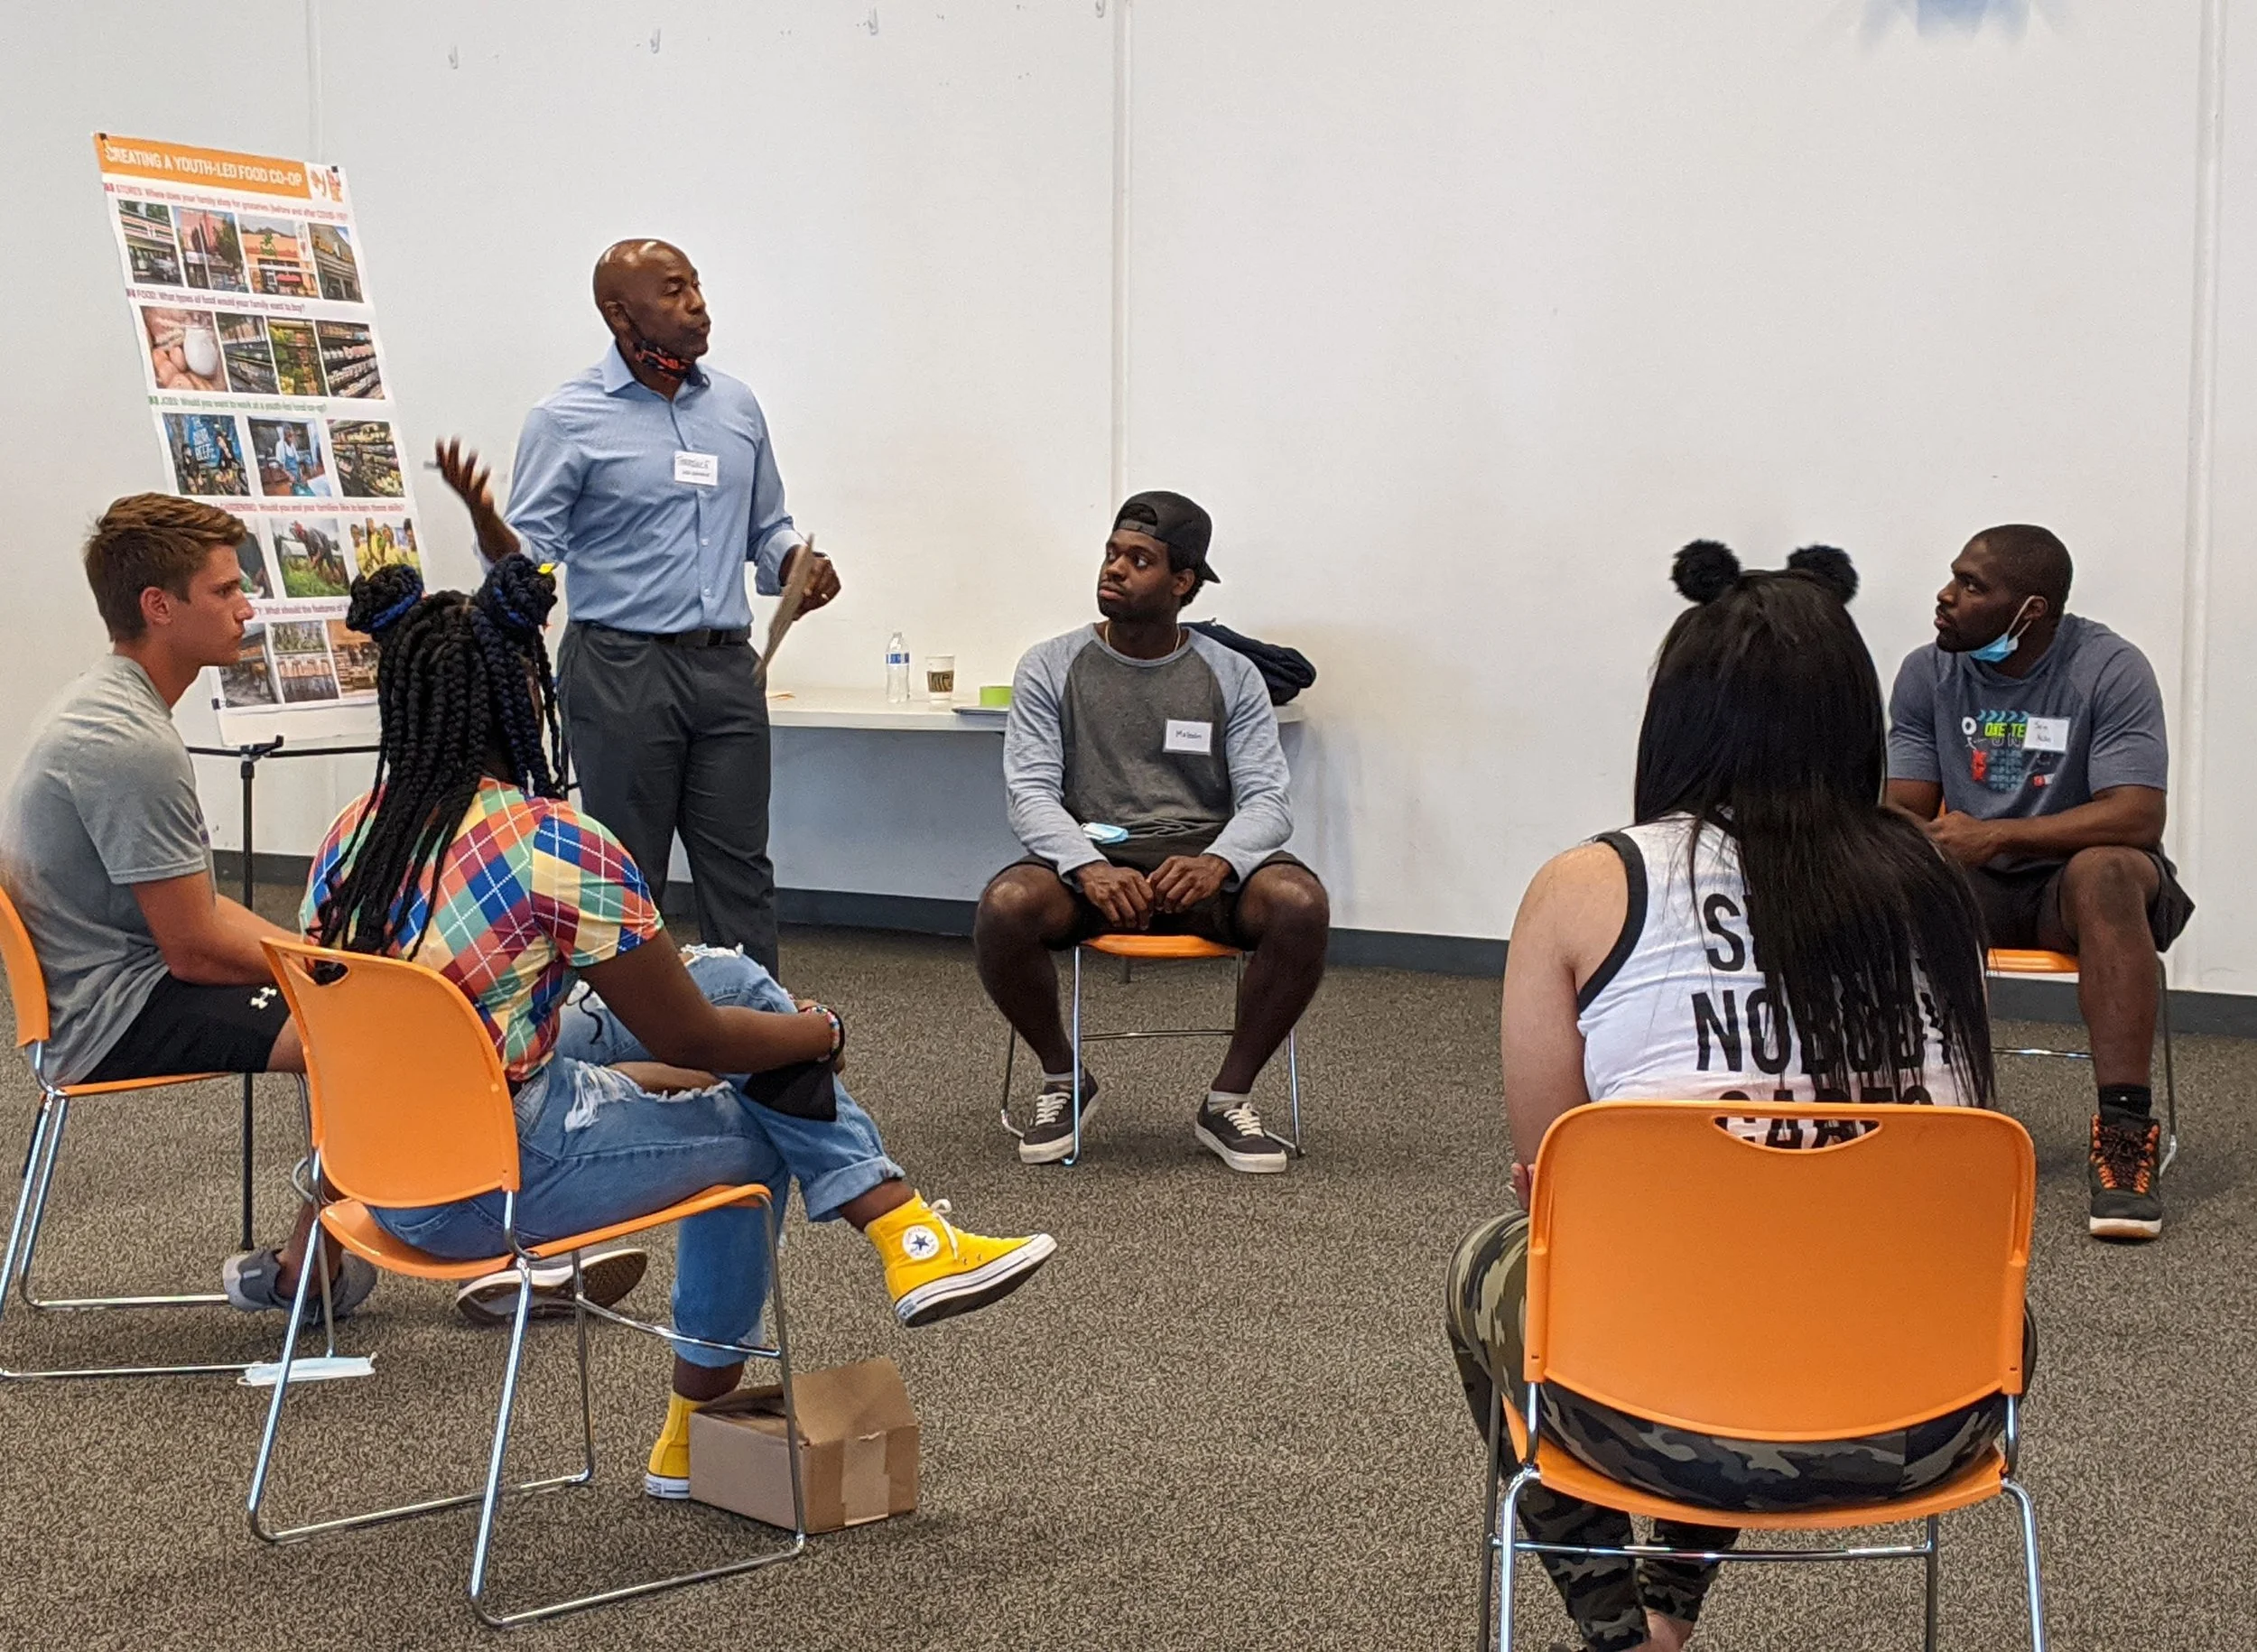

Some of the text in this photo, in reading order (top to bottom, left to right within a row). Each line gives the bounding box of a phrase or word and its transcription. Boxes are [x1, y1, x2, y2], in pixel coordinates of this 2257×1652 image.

[105, 146, 302, 187] CREATING A YOUTH-LED FOOD CO-OP
[2011, 723, 2028, 738] TE
